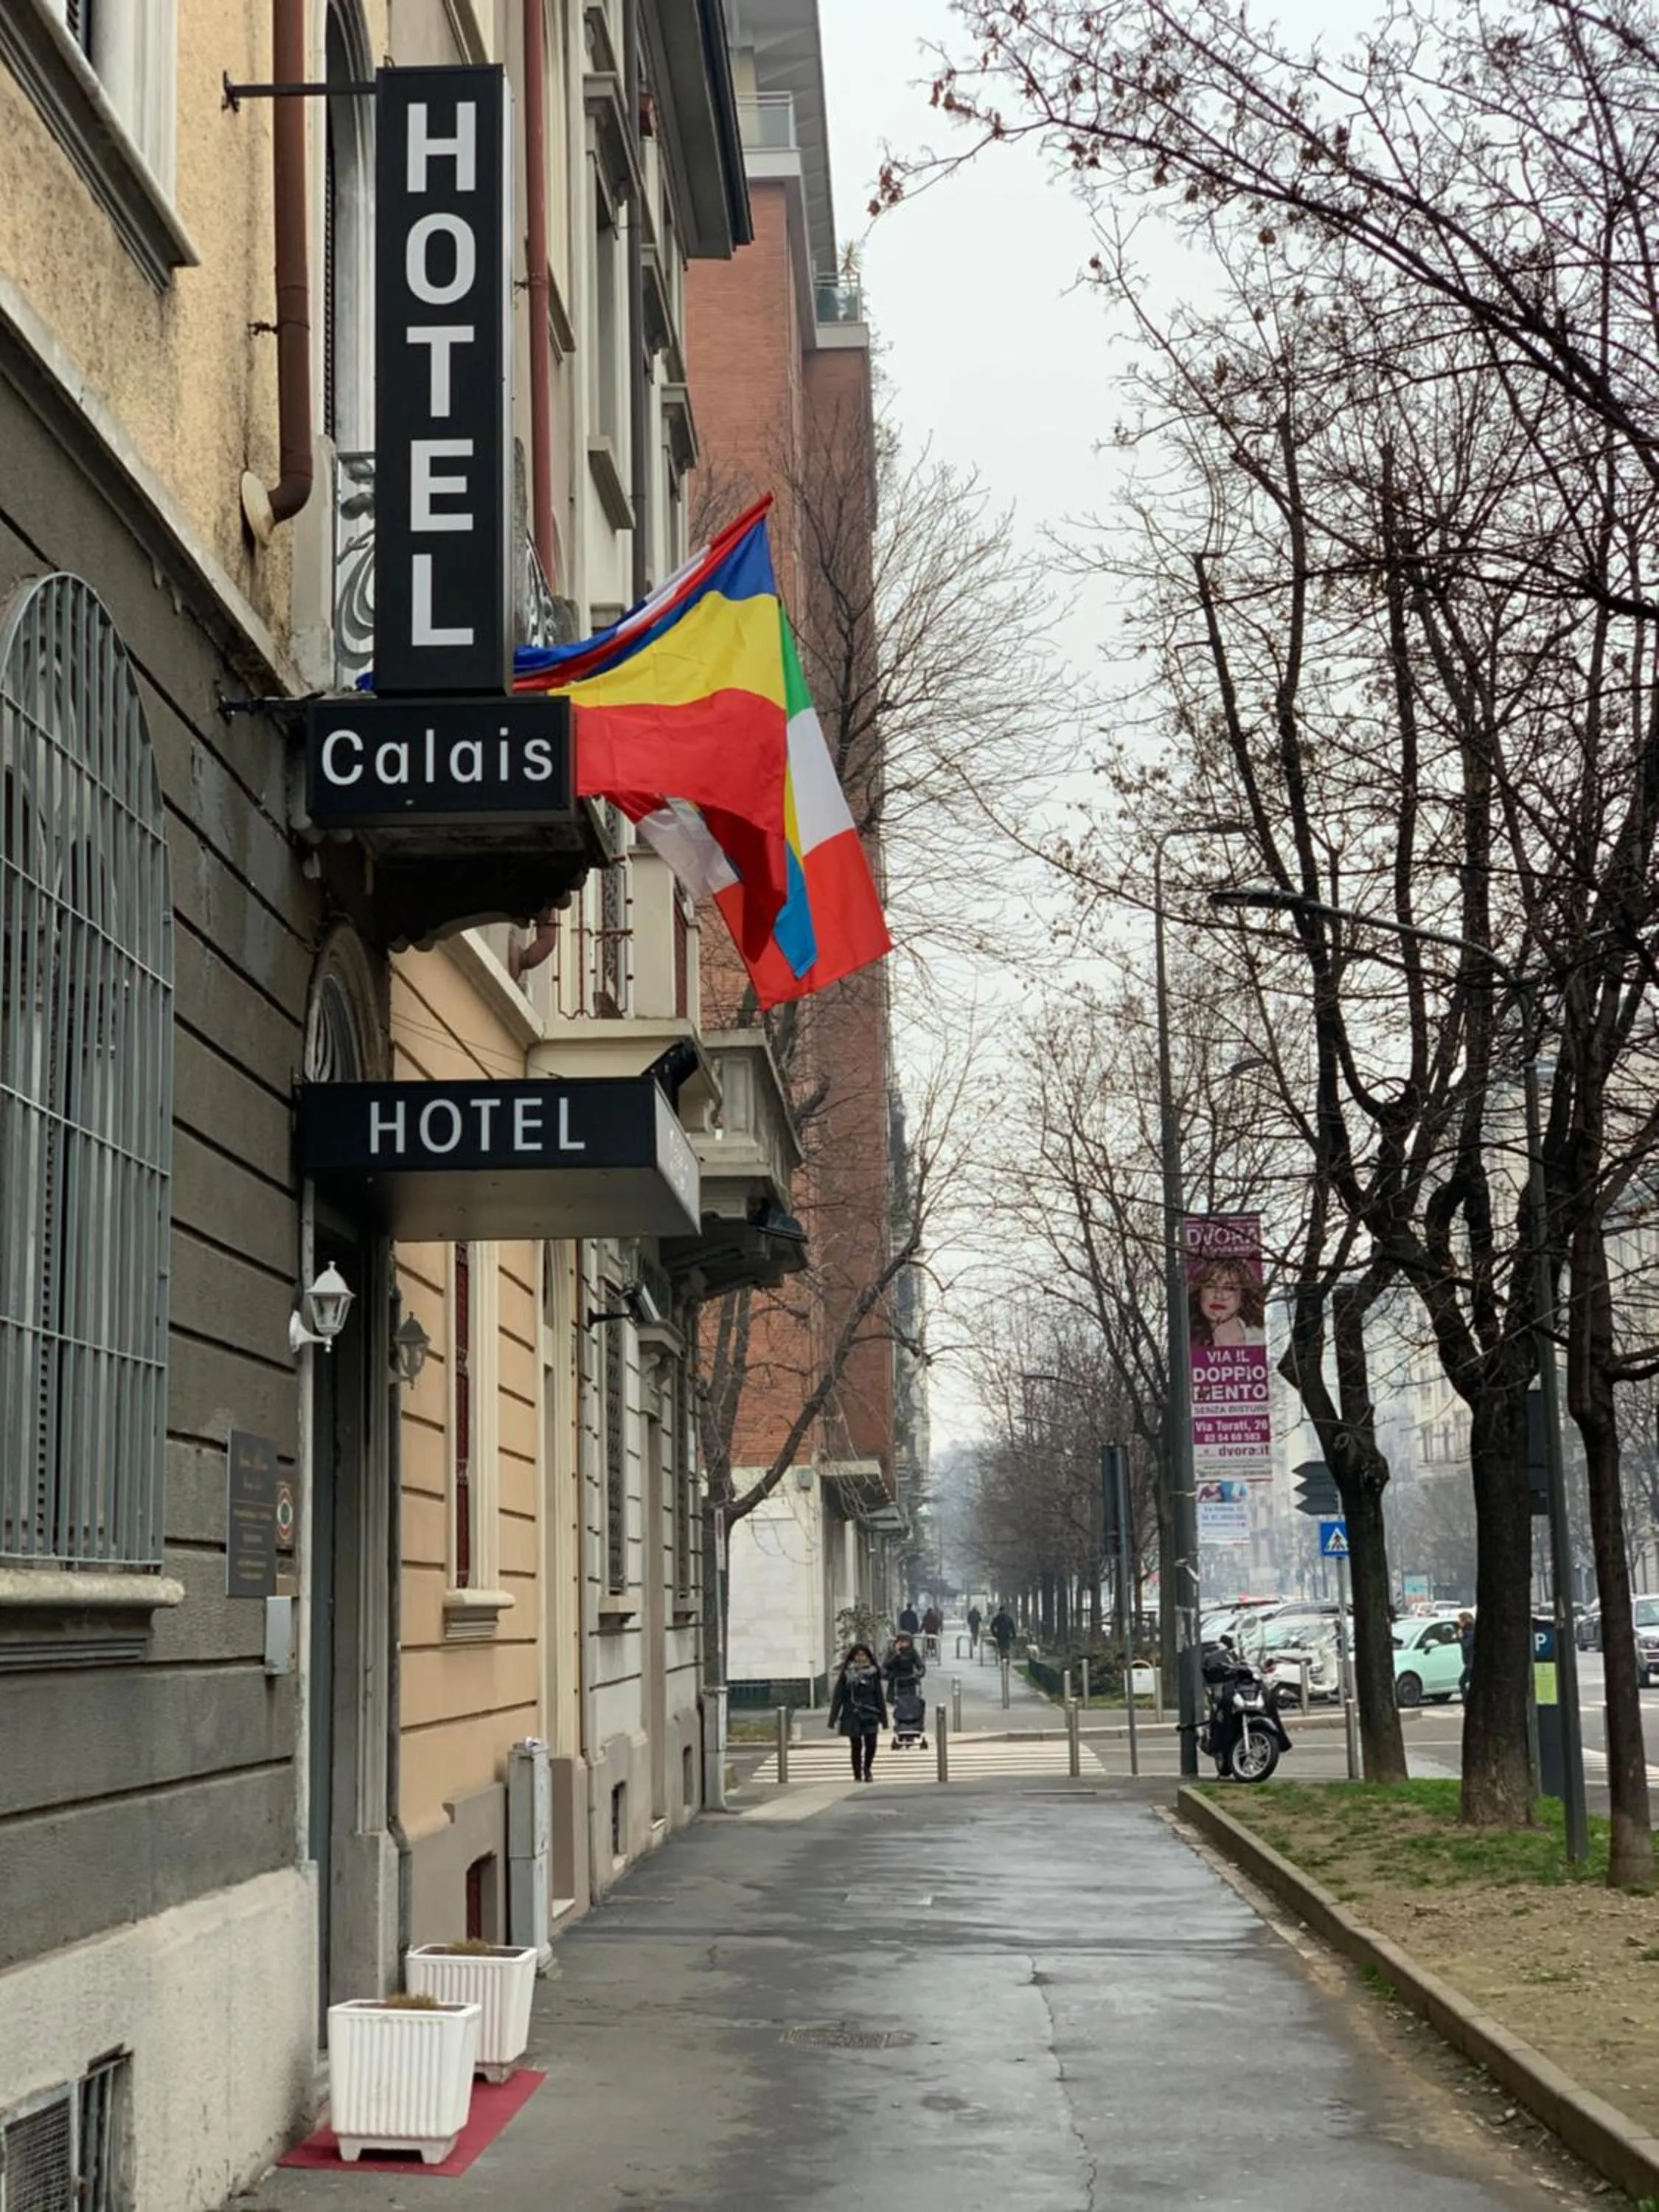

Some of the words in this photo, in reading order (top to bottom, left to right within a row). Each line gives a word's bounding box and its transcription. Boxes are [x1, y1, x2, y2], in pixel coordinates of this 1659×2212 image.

[405, 101, 476, 647] HOTEL
[321, 727, 553, 786] Calais
[369, 1097, 586, 1154] HOTEL
[1206, 1349, 1232, 1363] VIA
[1236, 1349, 1251, 1363] IL
[1192, 1365, 1266, 1382] DOPPIO
[1194, 1420, 1213, 1433] Via
[1215, 1419, 1251, 1432] Turati,
[1534, 1631, 1548, 1652] P
